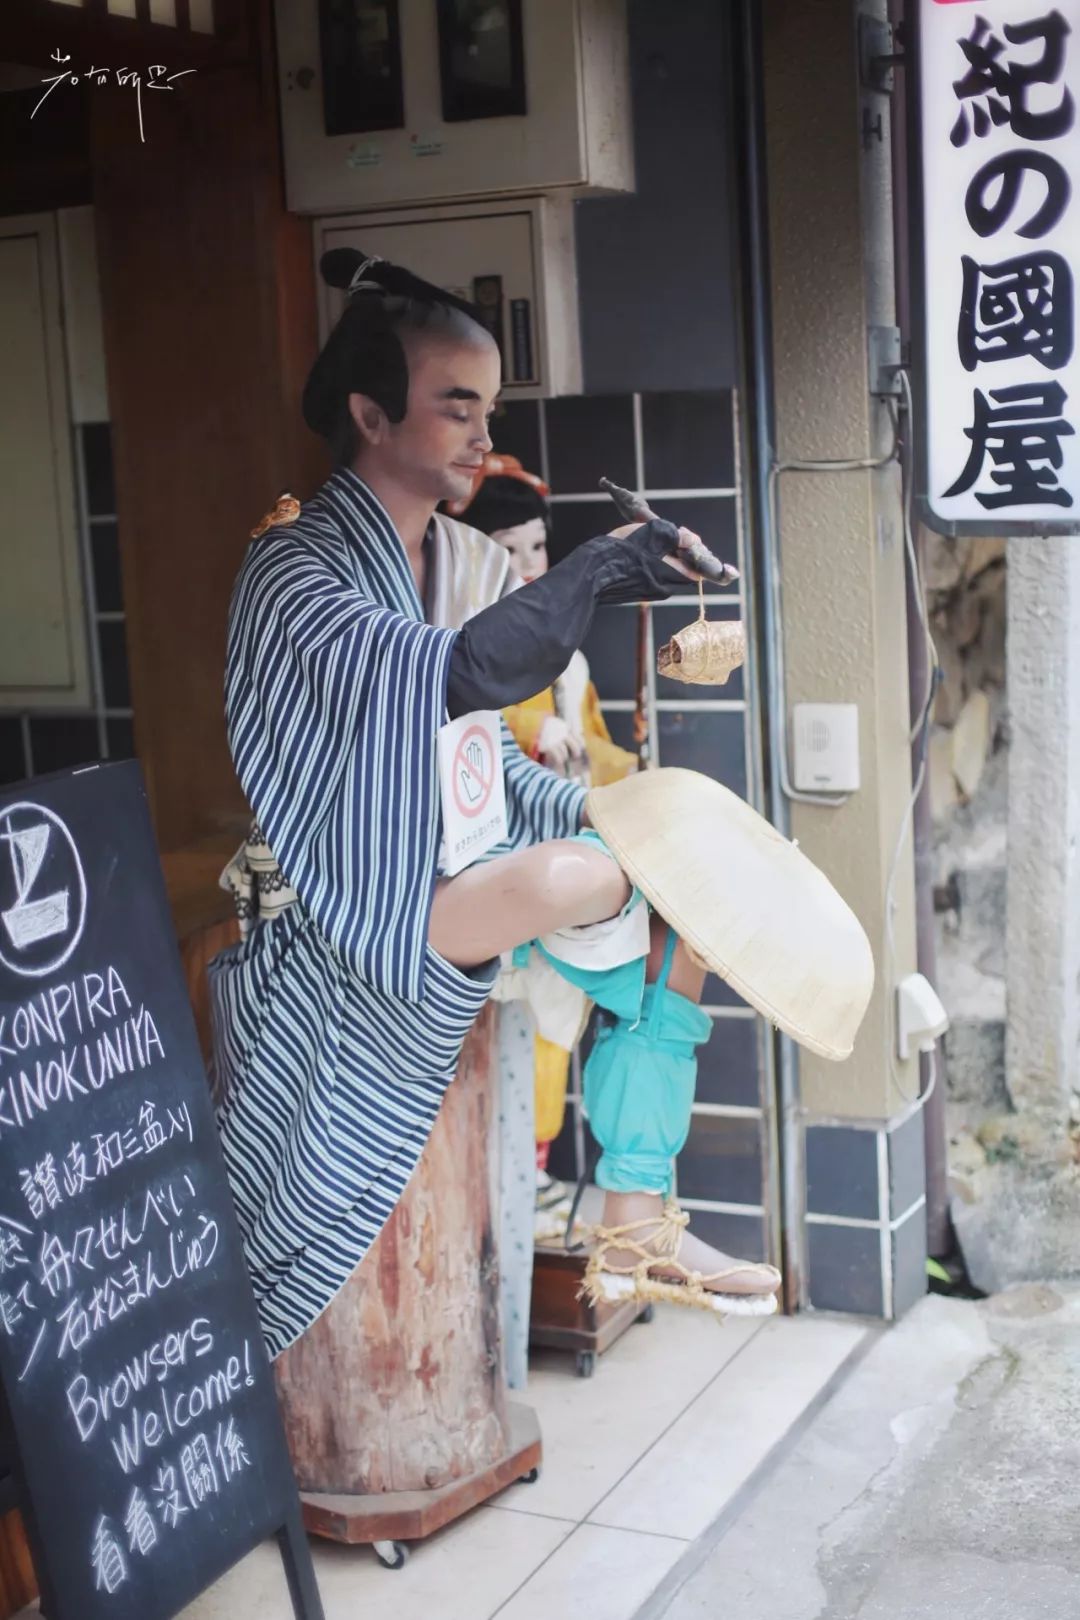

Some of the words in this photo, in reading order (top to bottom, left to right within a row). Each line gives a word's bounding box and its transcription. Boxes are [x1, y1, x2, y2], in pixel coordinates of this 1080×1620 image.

[940, 8, 1076, 511] 紀の國屋
[0, 966, 132, 1056] KONPIRA
[56, 1214, 219, 1359] 石松まんじゅう
[66, 1318, 214, 1442] Browsers
[110, 1339, 255, 1475] Welcome!
